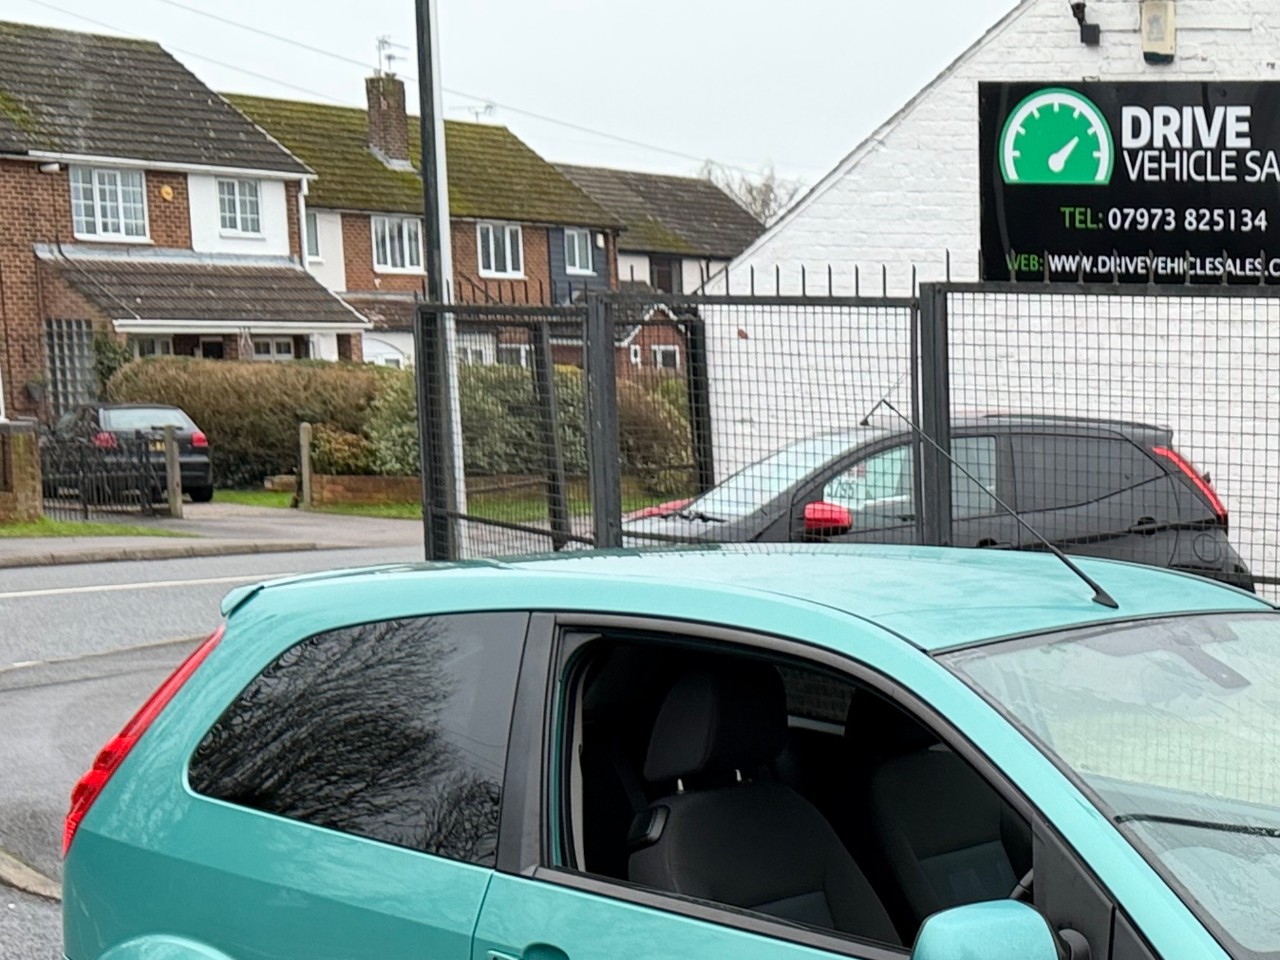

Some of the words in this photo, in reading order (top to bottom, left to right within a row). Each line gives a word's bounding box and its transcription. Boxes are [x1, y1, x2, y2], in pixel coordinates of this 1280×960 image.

[1120, 105, 1252, 150] DRIVE
[1123, 150, 1238, 182] VEHICLE
[1060, 206, 1104, 230] TEL:
[1107, 207, 1176, 232] 07973
[1184, 207, 1268, 232] 825134
[1006, 252, 1043, 272] WEB:
